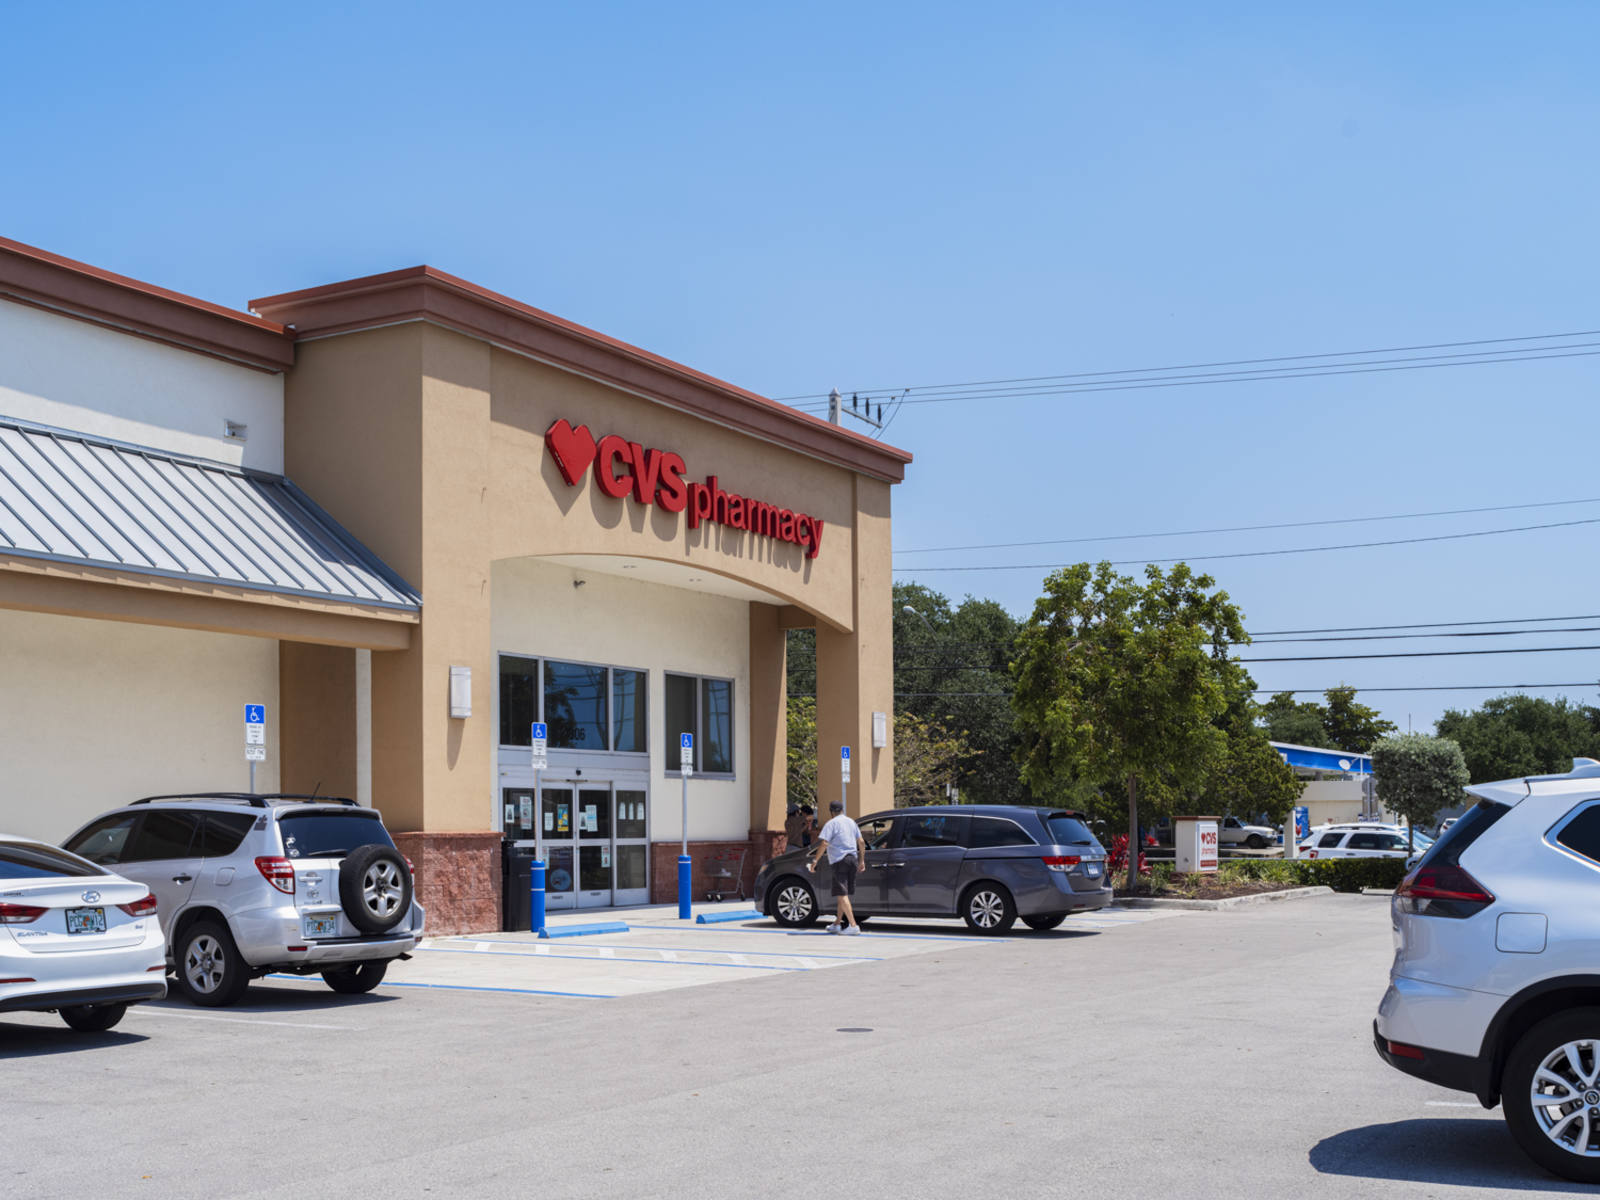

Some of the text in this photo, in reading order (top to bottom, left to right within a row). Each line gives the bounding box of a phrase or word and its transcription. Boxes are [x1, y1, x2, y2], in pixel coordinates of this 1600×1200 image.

[594, 434, 825, 559] CVS pharmacy
[1206, 832, 1216, 845] CVS
